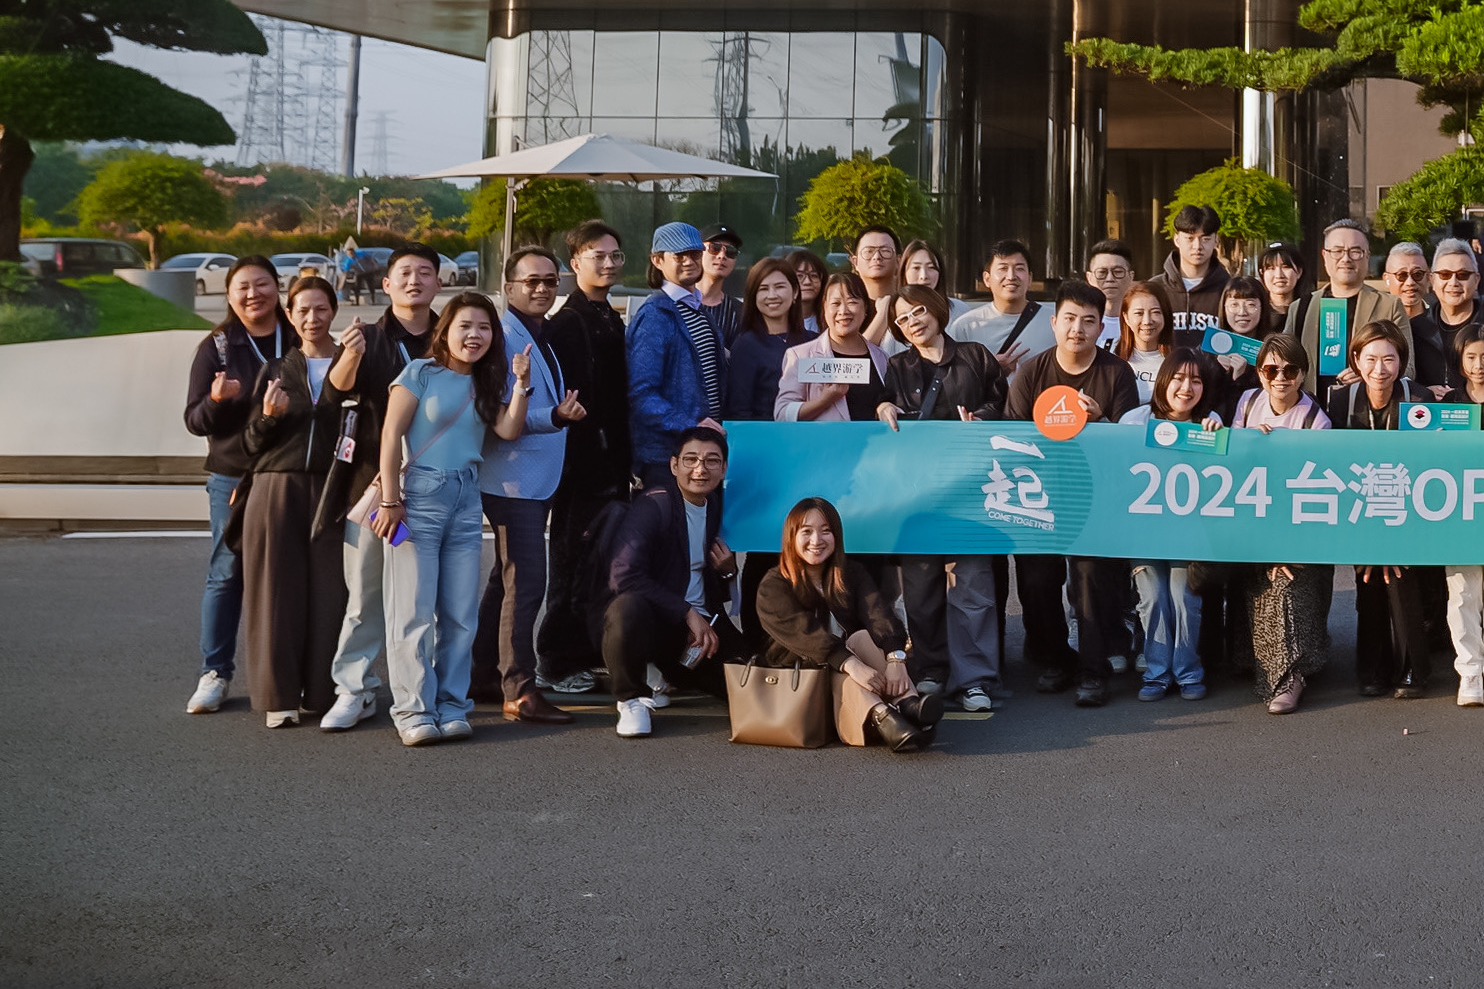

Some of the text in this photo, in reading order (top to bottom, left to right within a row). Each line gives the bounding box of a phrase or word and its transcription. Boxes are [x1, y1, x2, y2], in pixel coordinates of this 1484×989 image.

[1128, 463, 1272, 518] 2024
[988, 510, 1055, 532] COME TOGETHER
